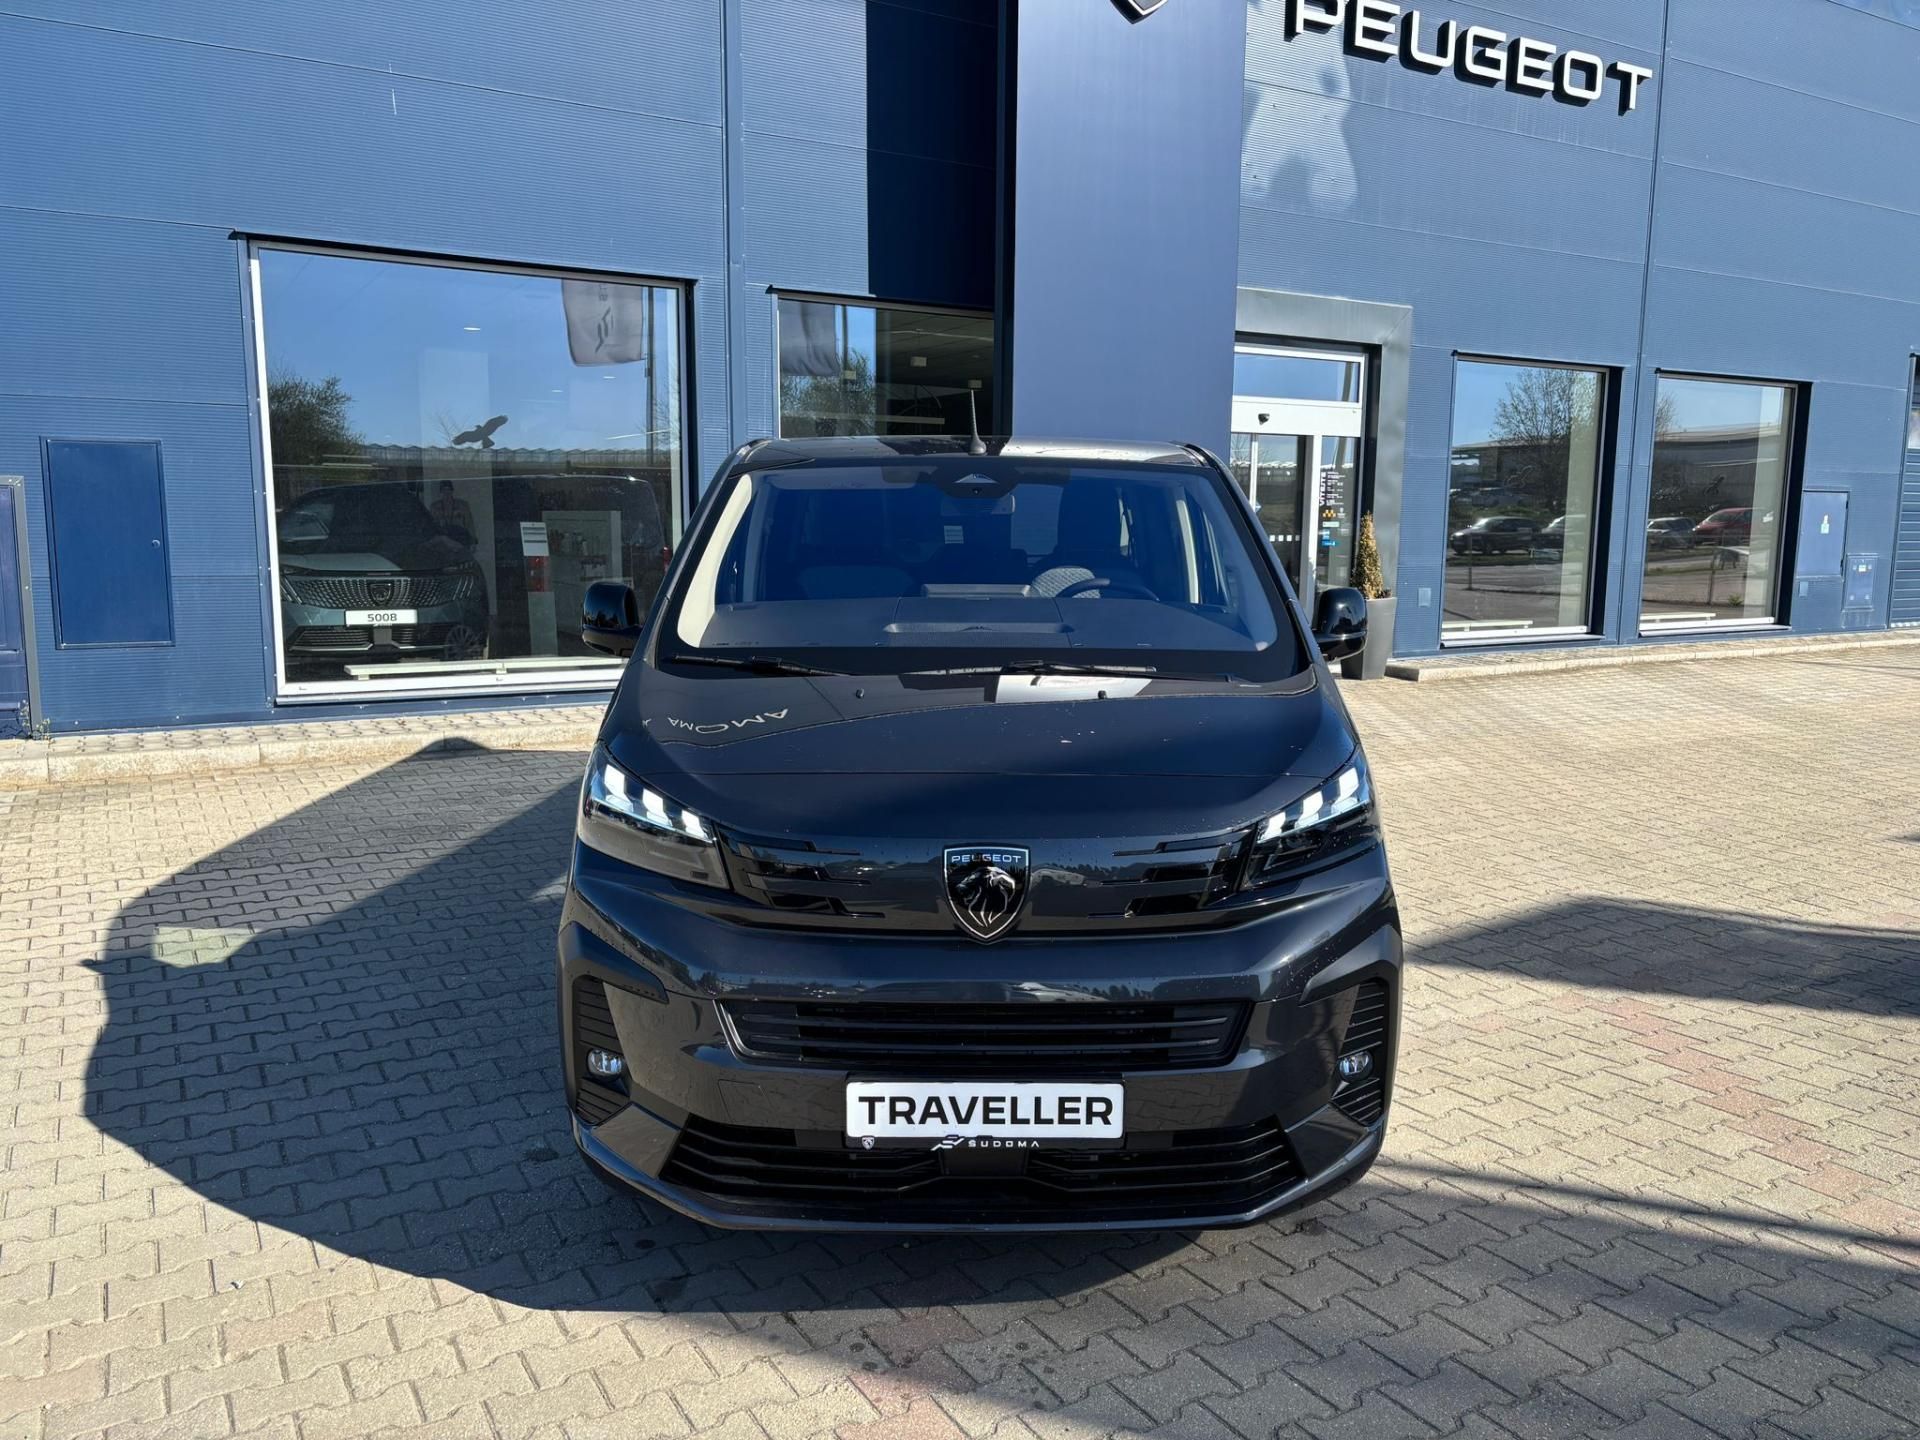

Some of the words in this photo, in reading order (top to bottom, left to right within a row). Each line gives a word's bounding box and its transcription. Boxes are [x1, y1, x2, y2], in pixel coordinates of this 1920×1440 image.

[1294, 0, 1653, 110] PEUGEOT
[367, 613, 398, 622] 5008
[951, 854, 1022, 863] PEUGEOT
[858, 1096, 1114, 1126] TRAVELLER
[968, 1139, 1040, 1148] SUDOMA
